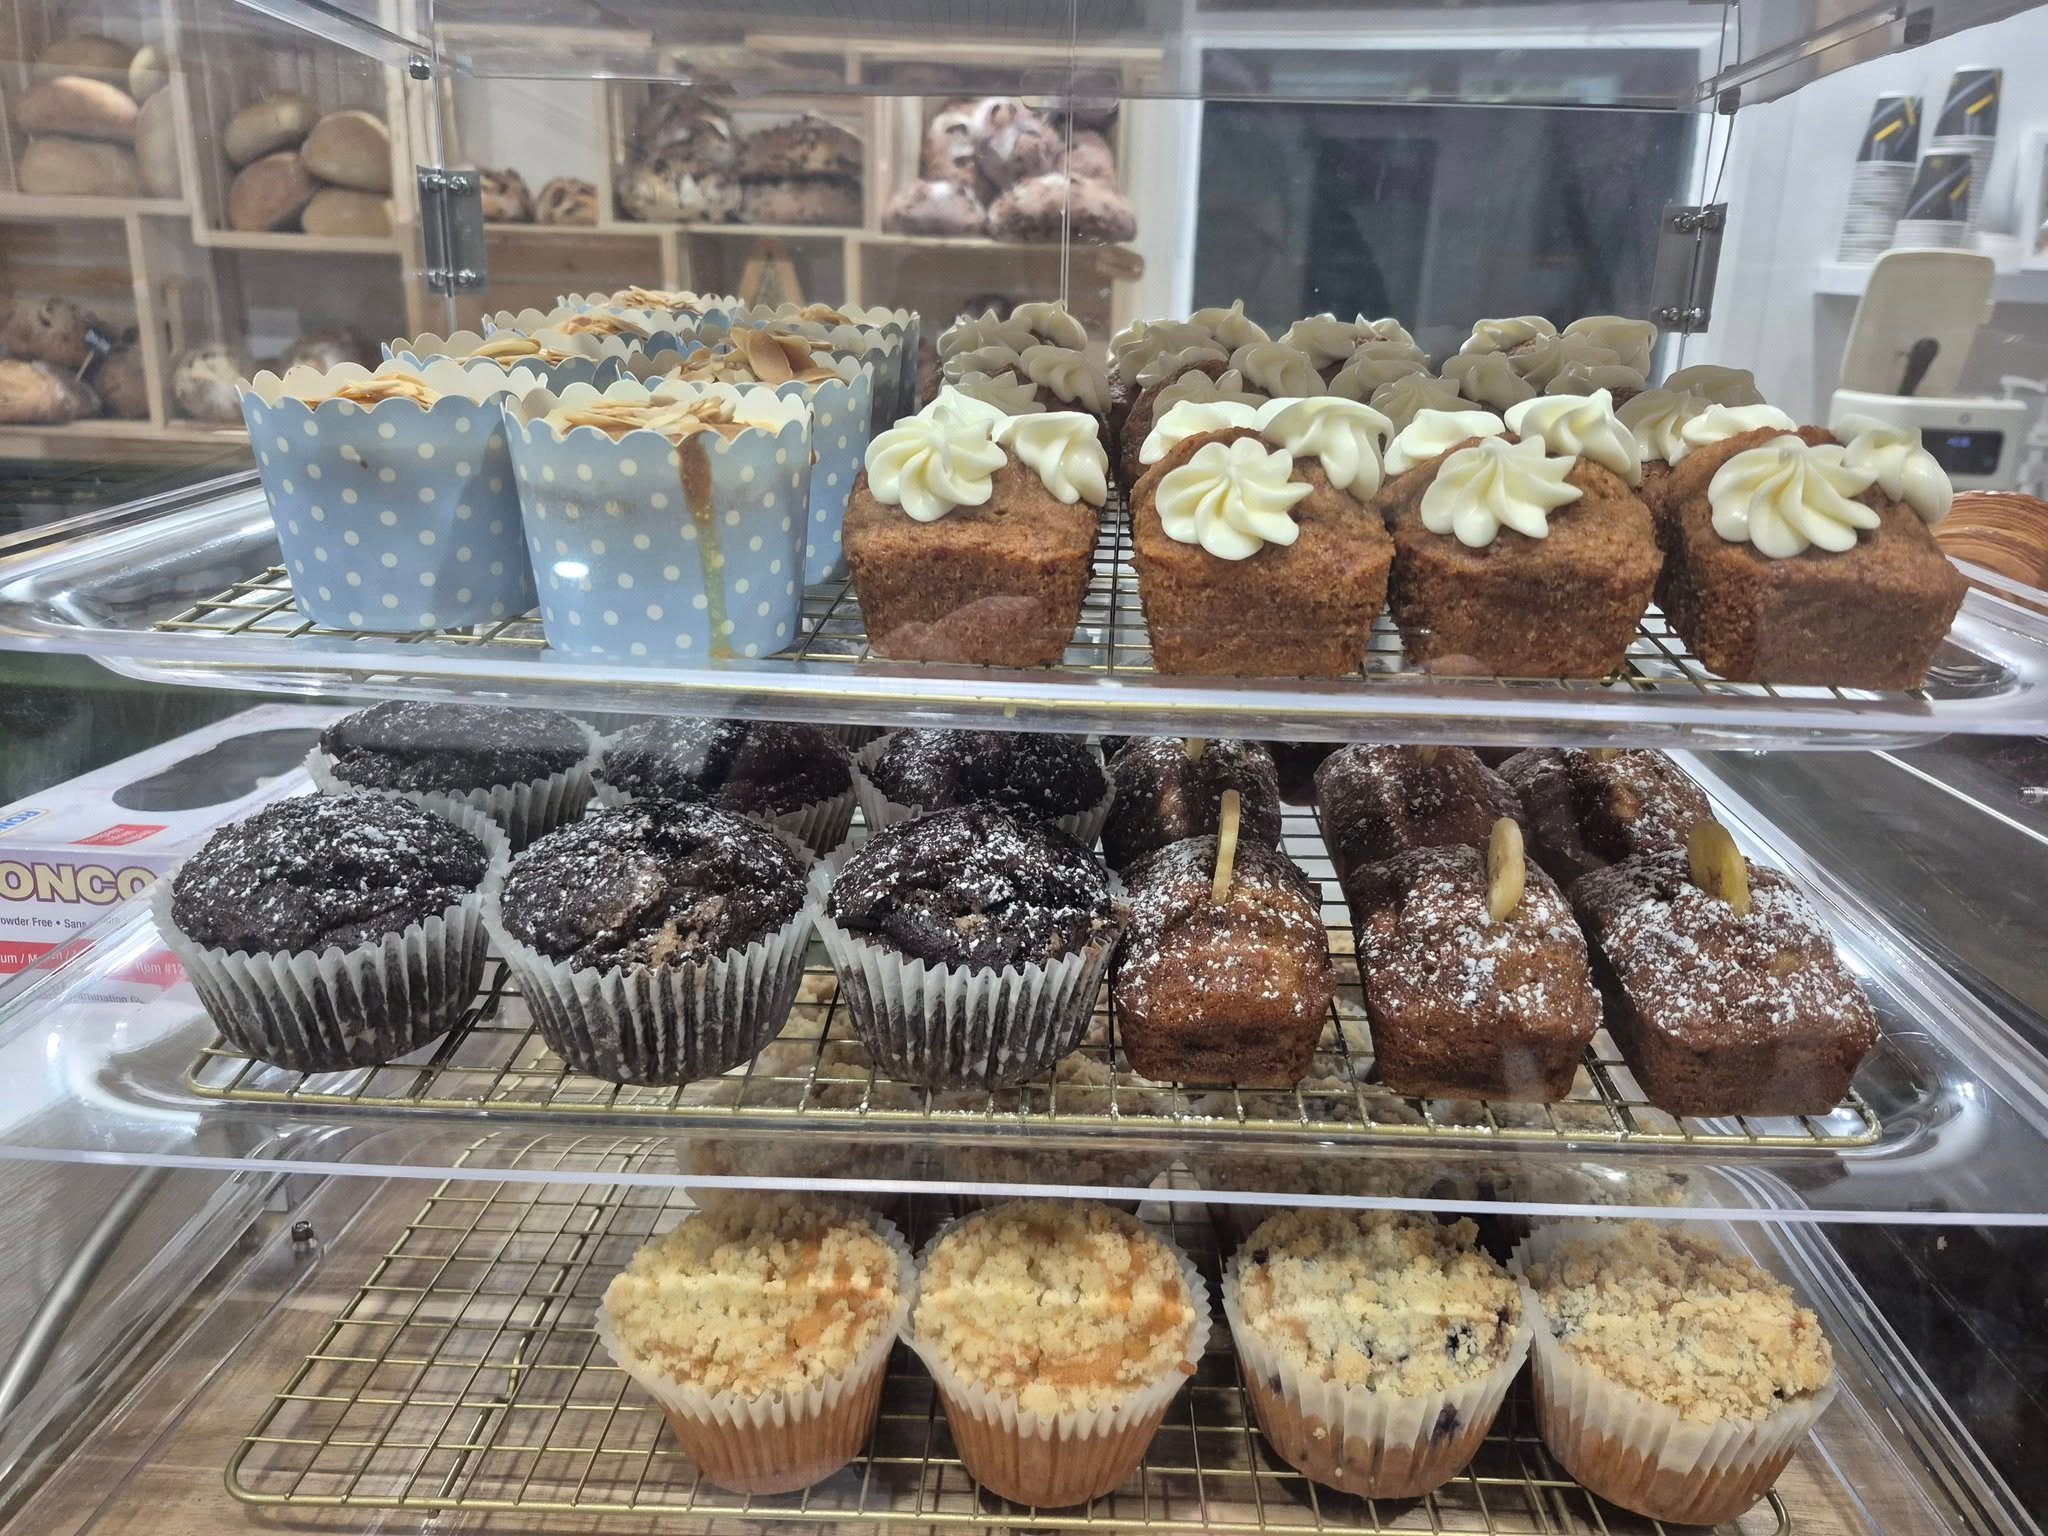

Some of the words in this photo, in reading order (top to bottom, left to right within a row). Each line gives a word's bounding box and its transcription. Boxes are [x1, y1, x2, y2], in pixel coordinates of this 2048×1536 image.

[0, 916, 30, 926] owder
[32, 917, 53, 928] Free
[64, 918, 87, 929] Sans
